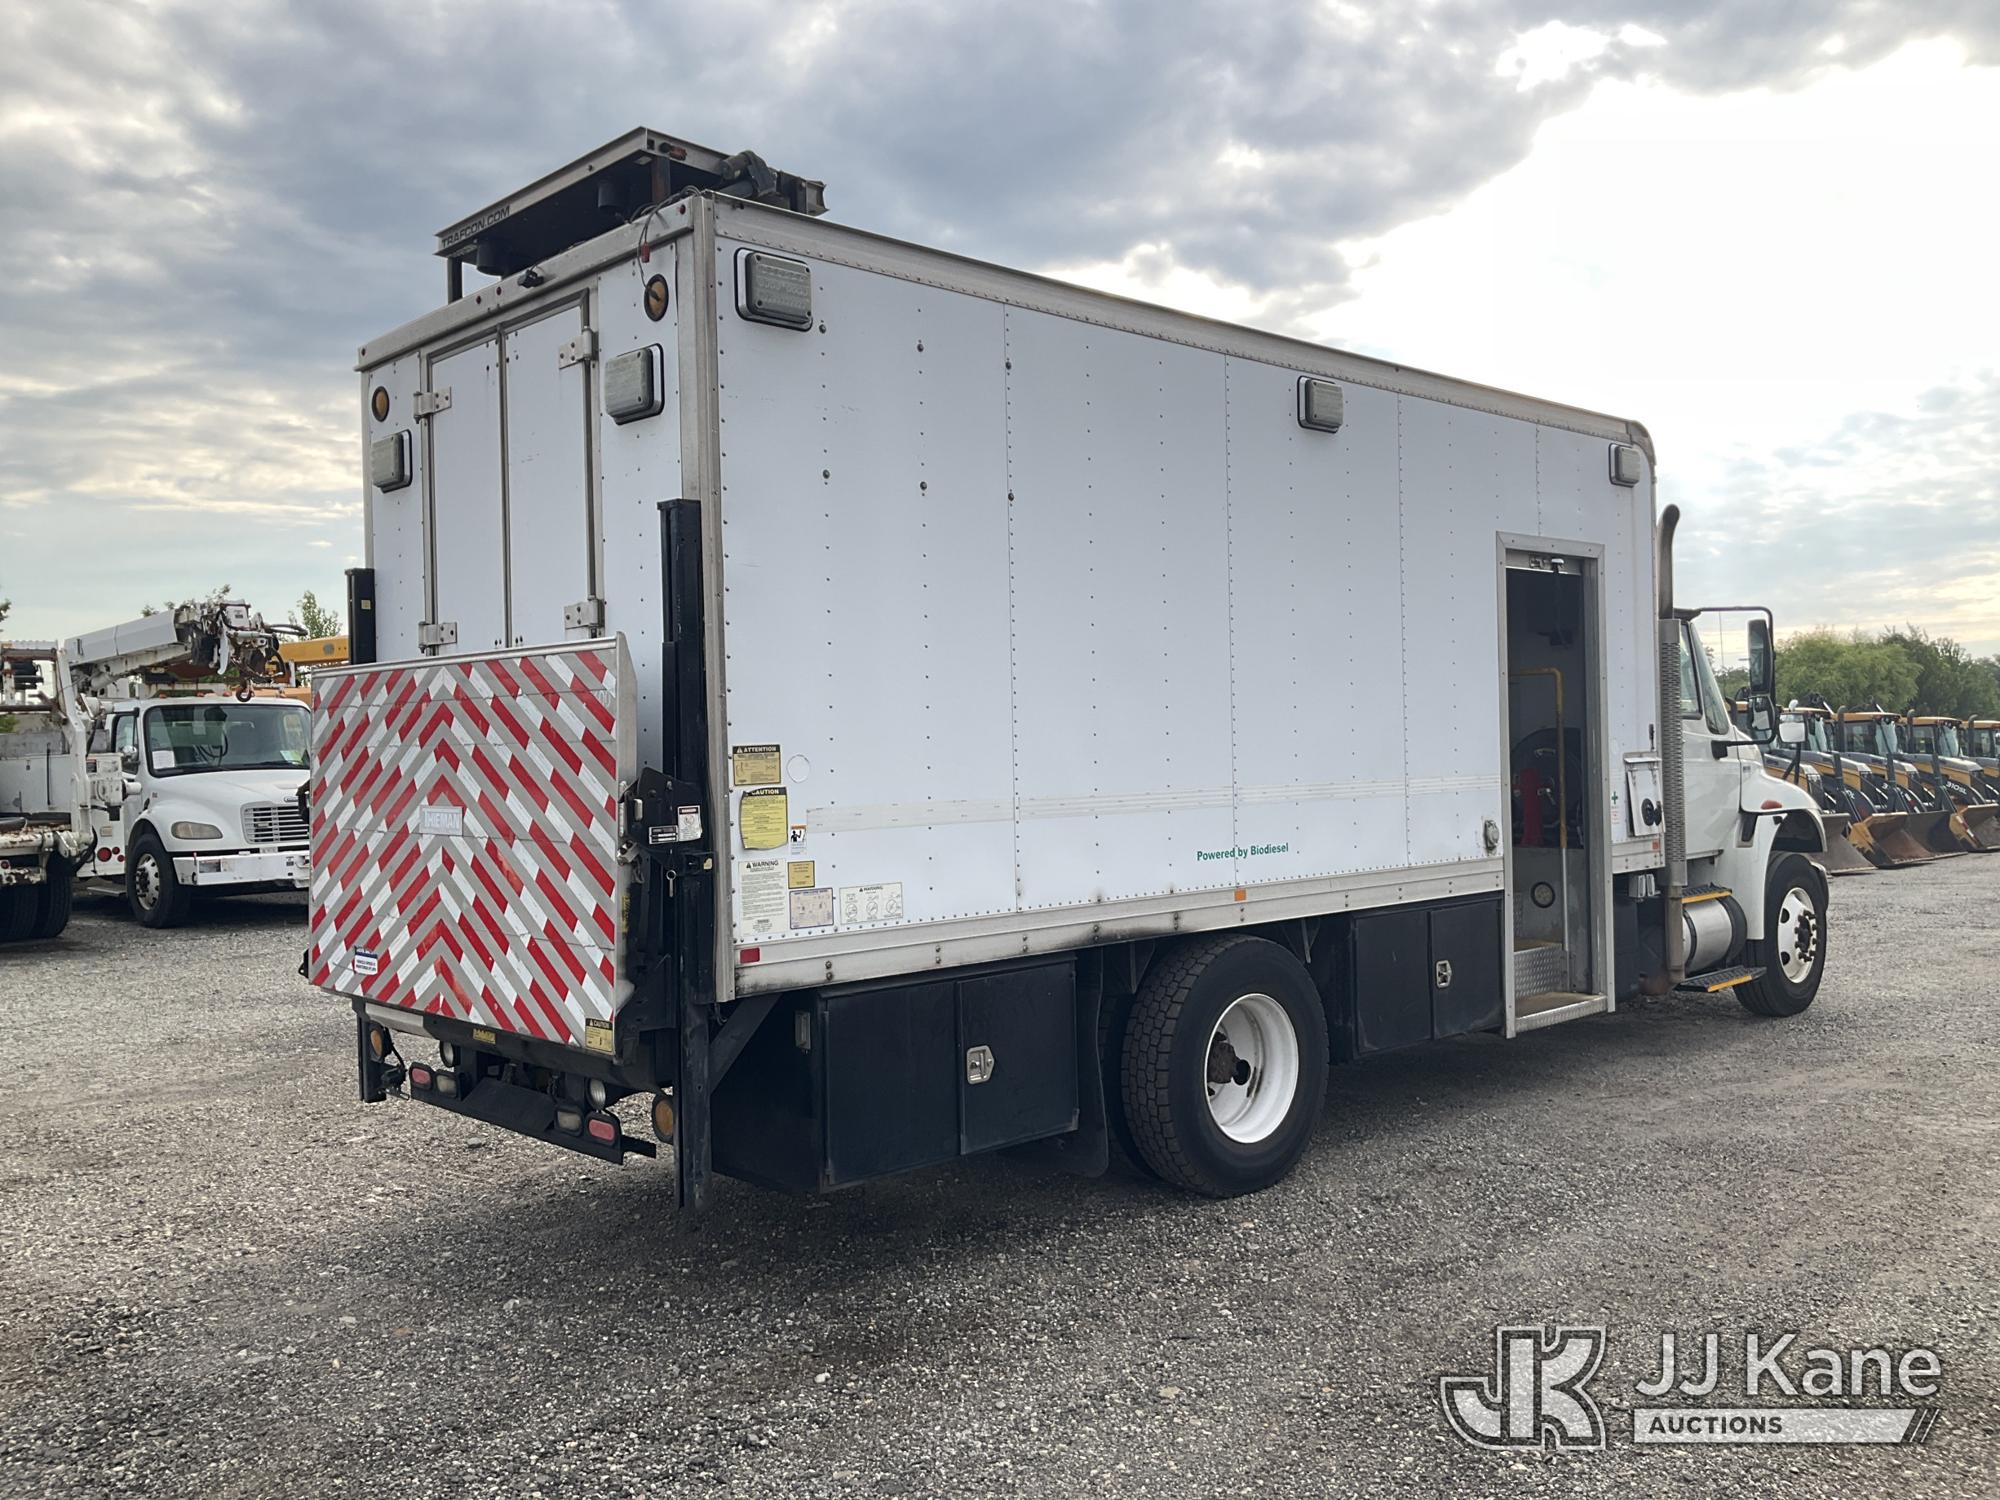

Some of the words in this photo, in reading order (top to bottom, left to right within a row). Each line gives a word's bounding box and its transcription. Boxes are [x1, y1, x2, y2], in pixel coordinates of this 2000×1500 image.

[441, 205, 511, 248] TRAFCON.COM
[1197, 847, 1236, 861] Powered
[1237, 847, 1249, 859] by
[1250, 842, 1289, 855] Biodiesel
